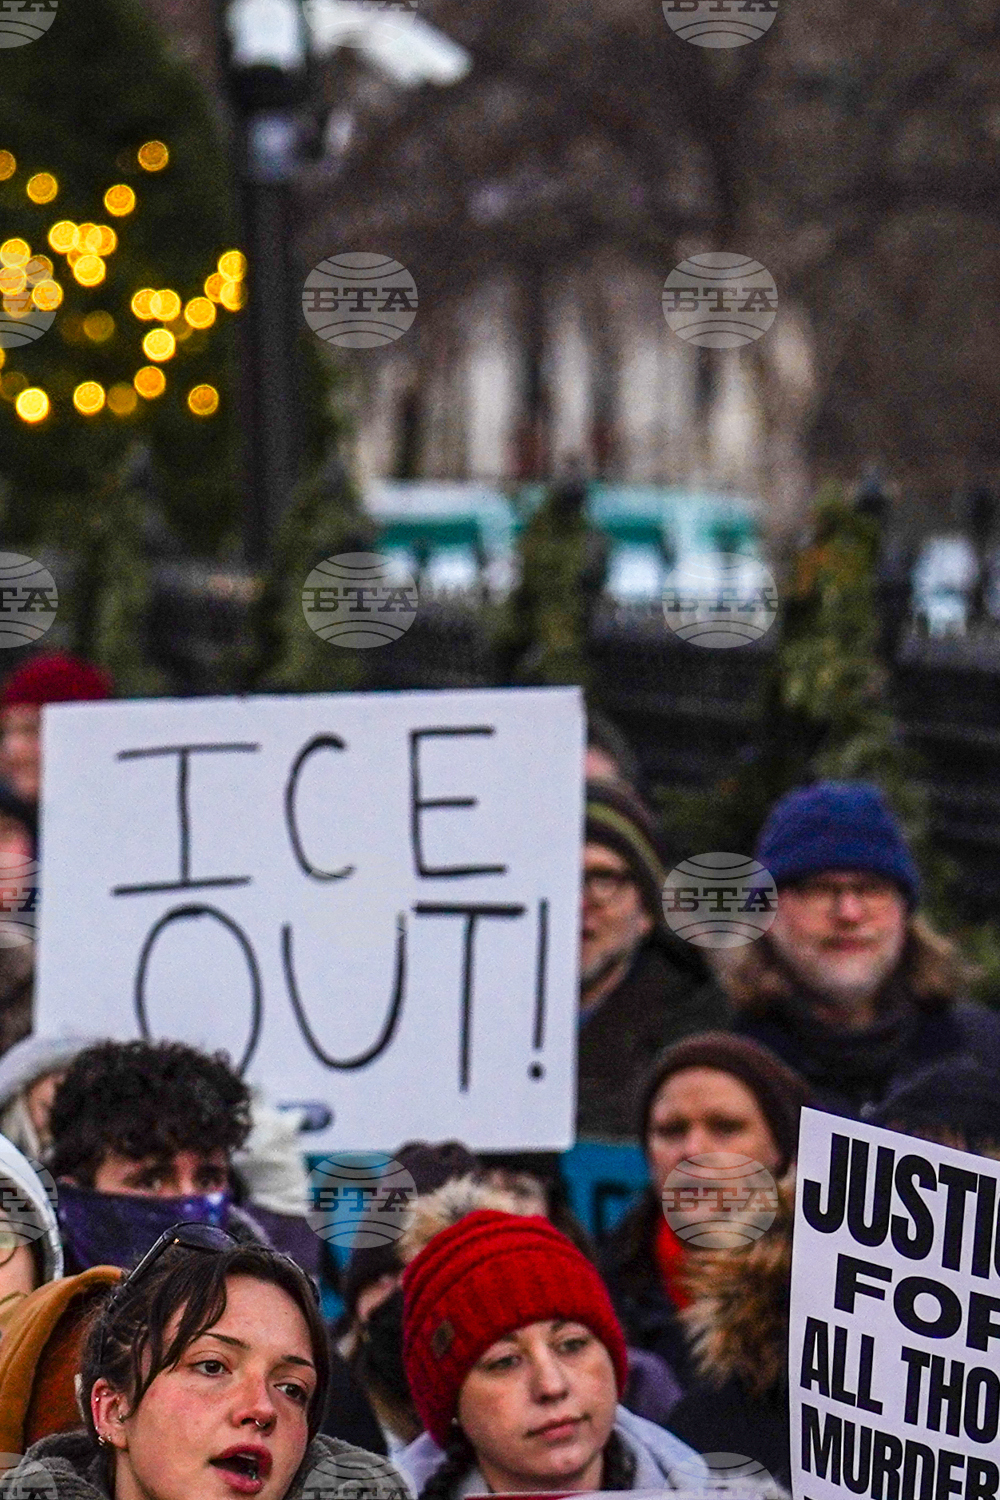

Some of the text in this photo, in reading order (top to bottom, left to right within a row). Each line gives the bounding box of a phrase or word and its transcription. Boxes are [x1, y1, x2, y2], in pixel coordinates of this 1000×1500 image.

[110, 725, 507, 896] ICE
[134, 898, 551, 1093] OUT!
[802, 1132, 1000, 1281] JUSTI
[799, 1316, 883, 1416] ALL
